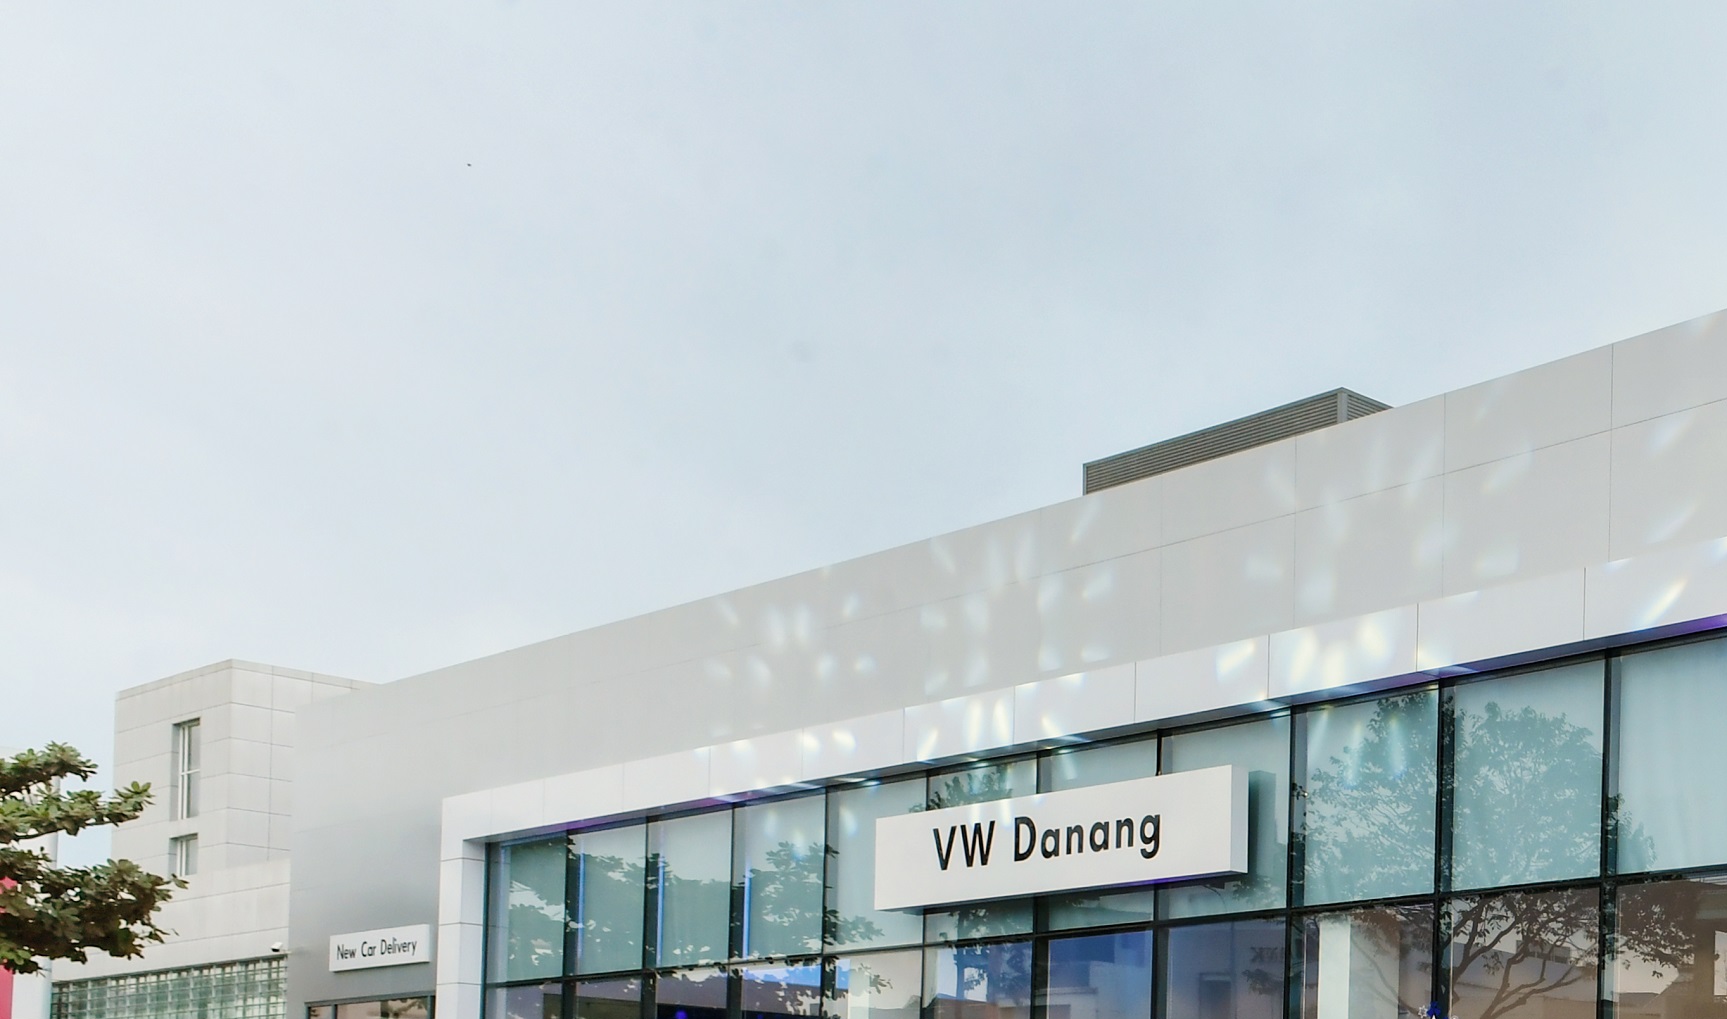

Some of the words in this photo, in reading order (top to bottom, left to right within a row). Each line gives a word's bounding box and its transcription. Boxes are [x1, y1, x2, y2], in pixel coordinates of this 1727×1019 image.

[933, 820, 996, 871] VW
[1014, 814, 1161, 859] Danang
[337, 944, 357, 960] New
[361, 941, 376, 957] Car
[380, 937, 417, 956] Delivery
